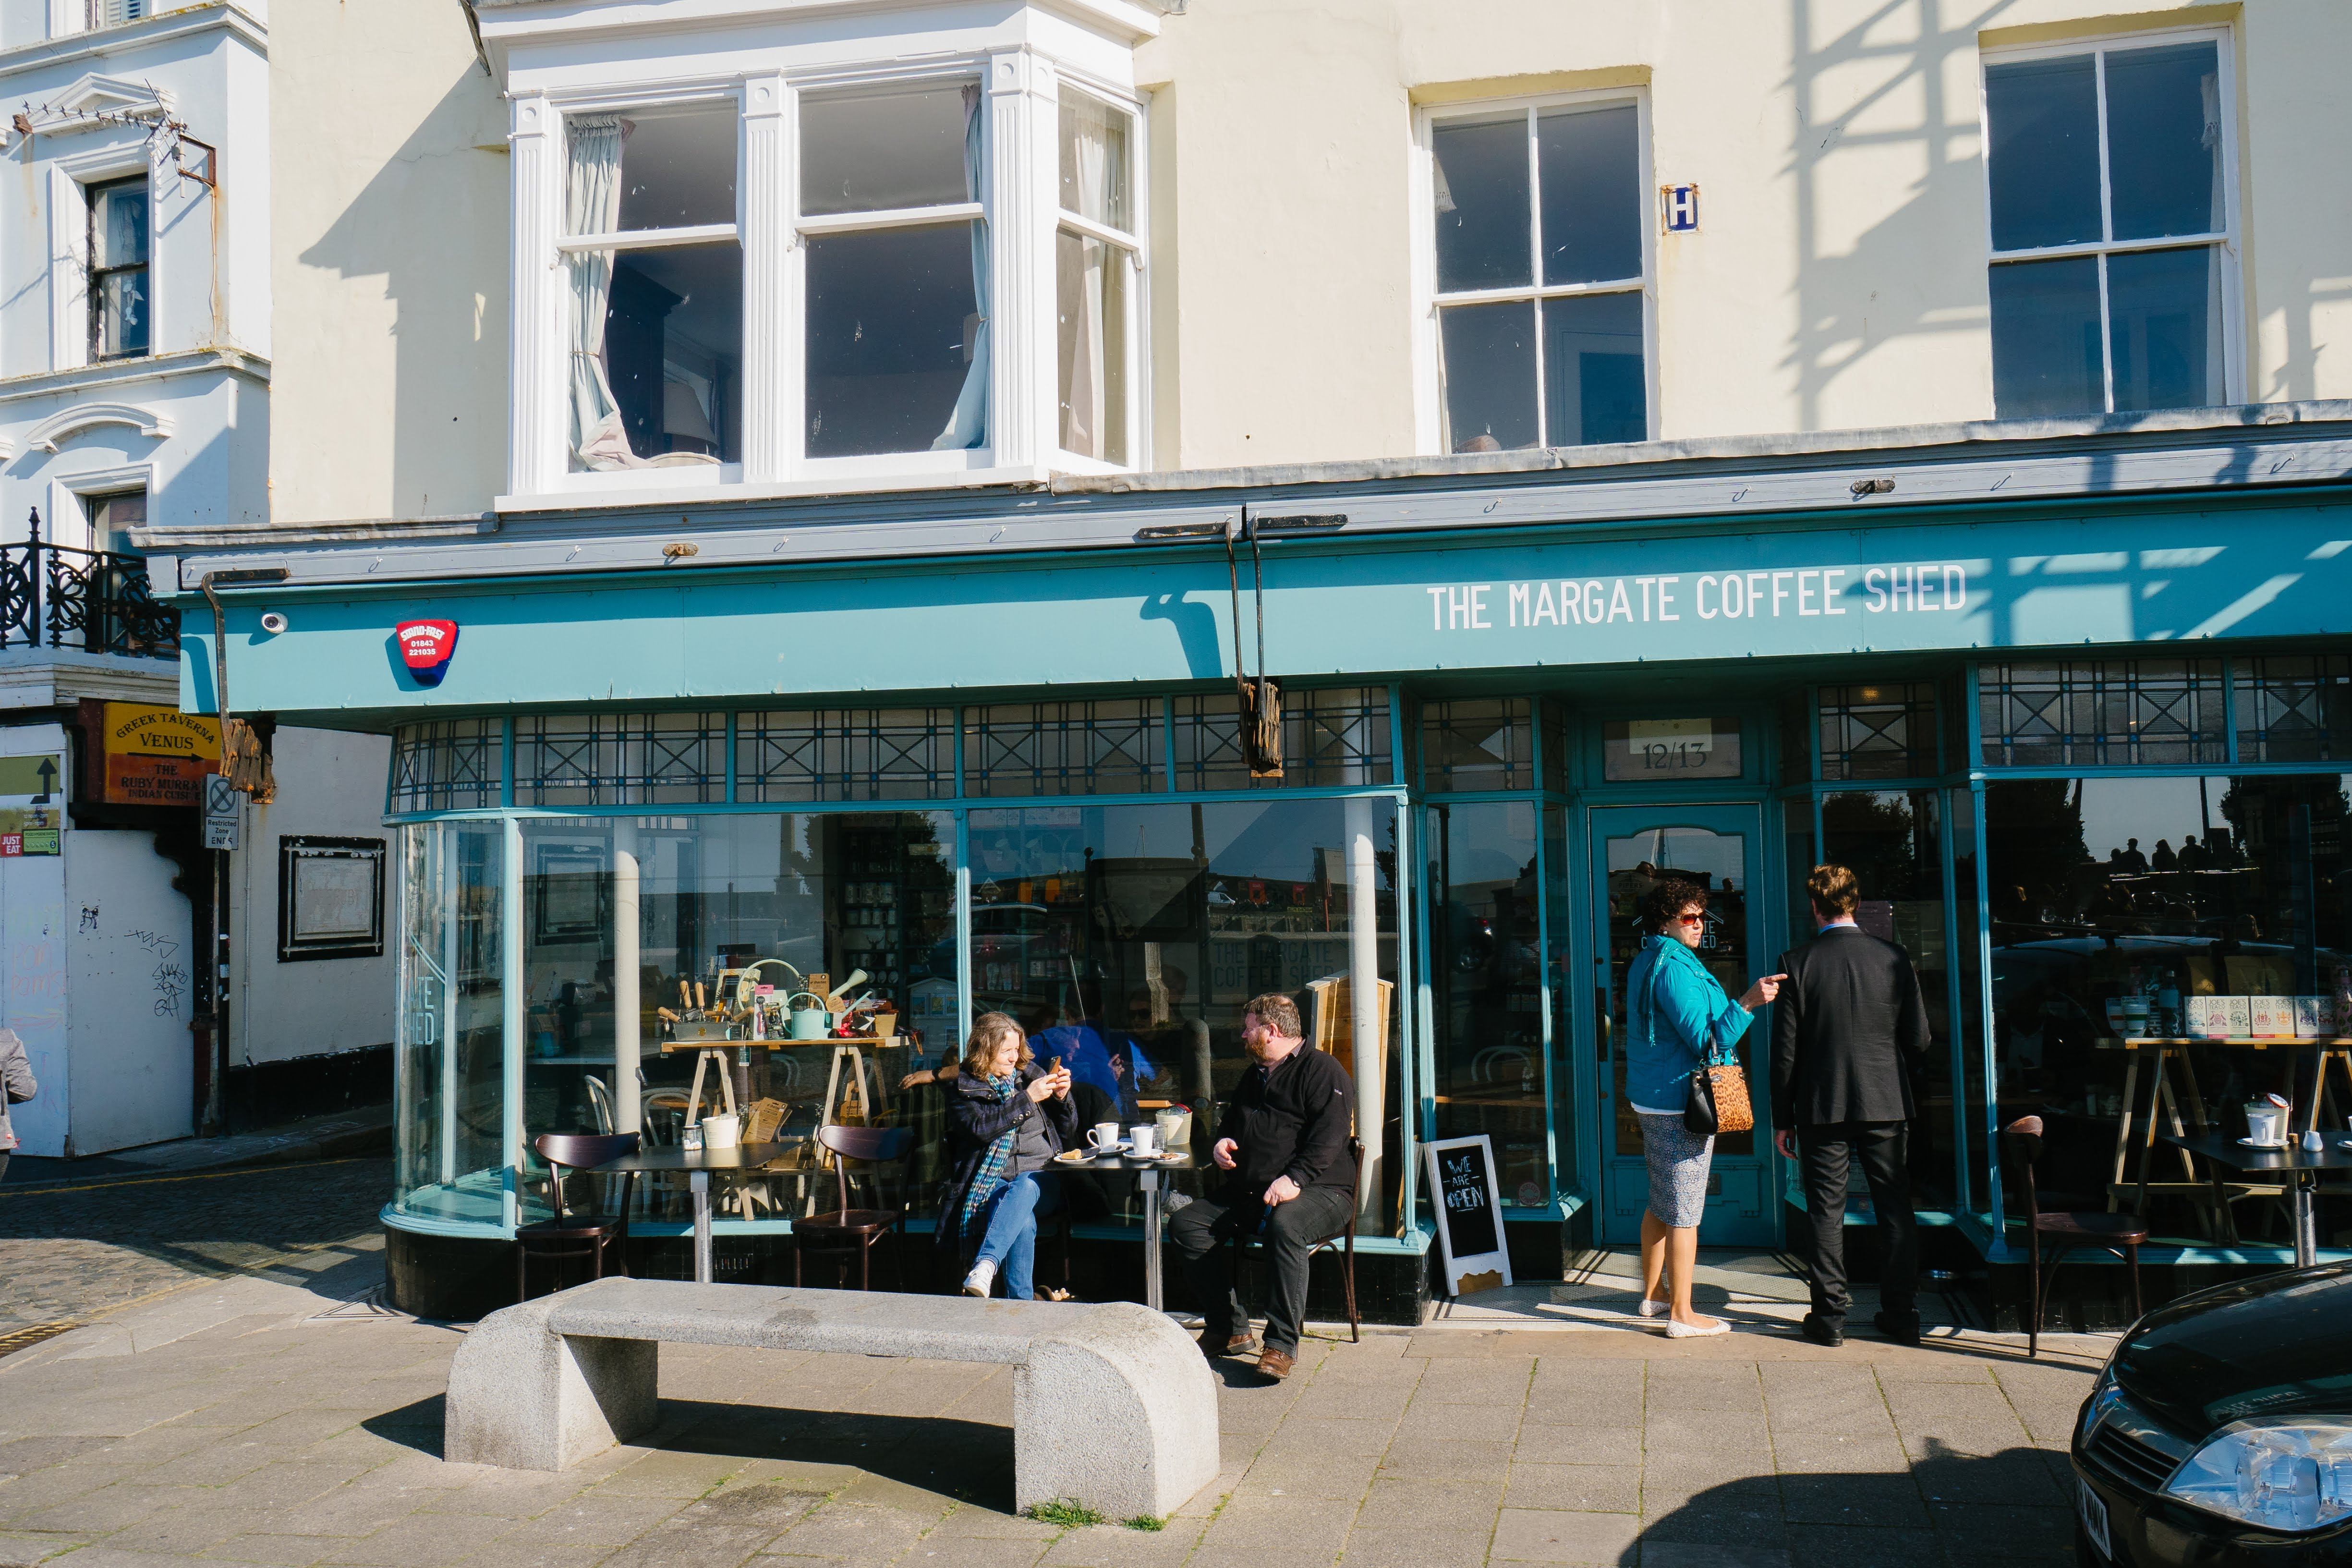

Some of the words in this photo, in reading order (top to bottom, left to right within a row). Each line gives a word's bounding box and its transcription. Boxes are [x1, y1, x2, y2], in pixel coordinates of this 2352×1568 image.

[1669, 191, 1694, 226] H
[1427, 584, 1491, 630] THE
[1509, 576, 1680, 627] MARGATE
[1697, 569, 1846, 620] COFFEE
[1865, 564, 1966, 613] SHED
[116, 714, 157, 738] GREEK
[159, 713, 215, 744] TAVERNA
[139, 732, 194, 749] VENUS
[1642, 741, 1707, 771] 12/13
[154, 764, 178, 776] THE
[121, 777, 156, 788] RUBY
[158, 778, 202, 790] MURRA
[128, 789, 162, 799] INDIAN
[2, 836, 21, 845] JUST
[6, 845, 21, 853] EAT
[1213, 942, 1245, 964] THE
[1213, 966, 1282, 987] COFFEE
[1447, 1155, 1472, 1174] WE
[1452, 1174, 1470, 1187] ARE
[1447, 1185, 1484, 1208] OPEN
